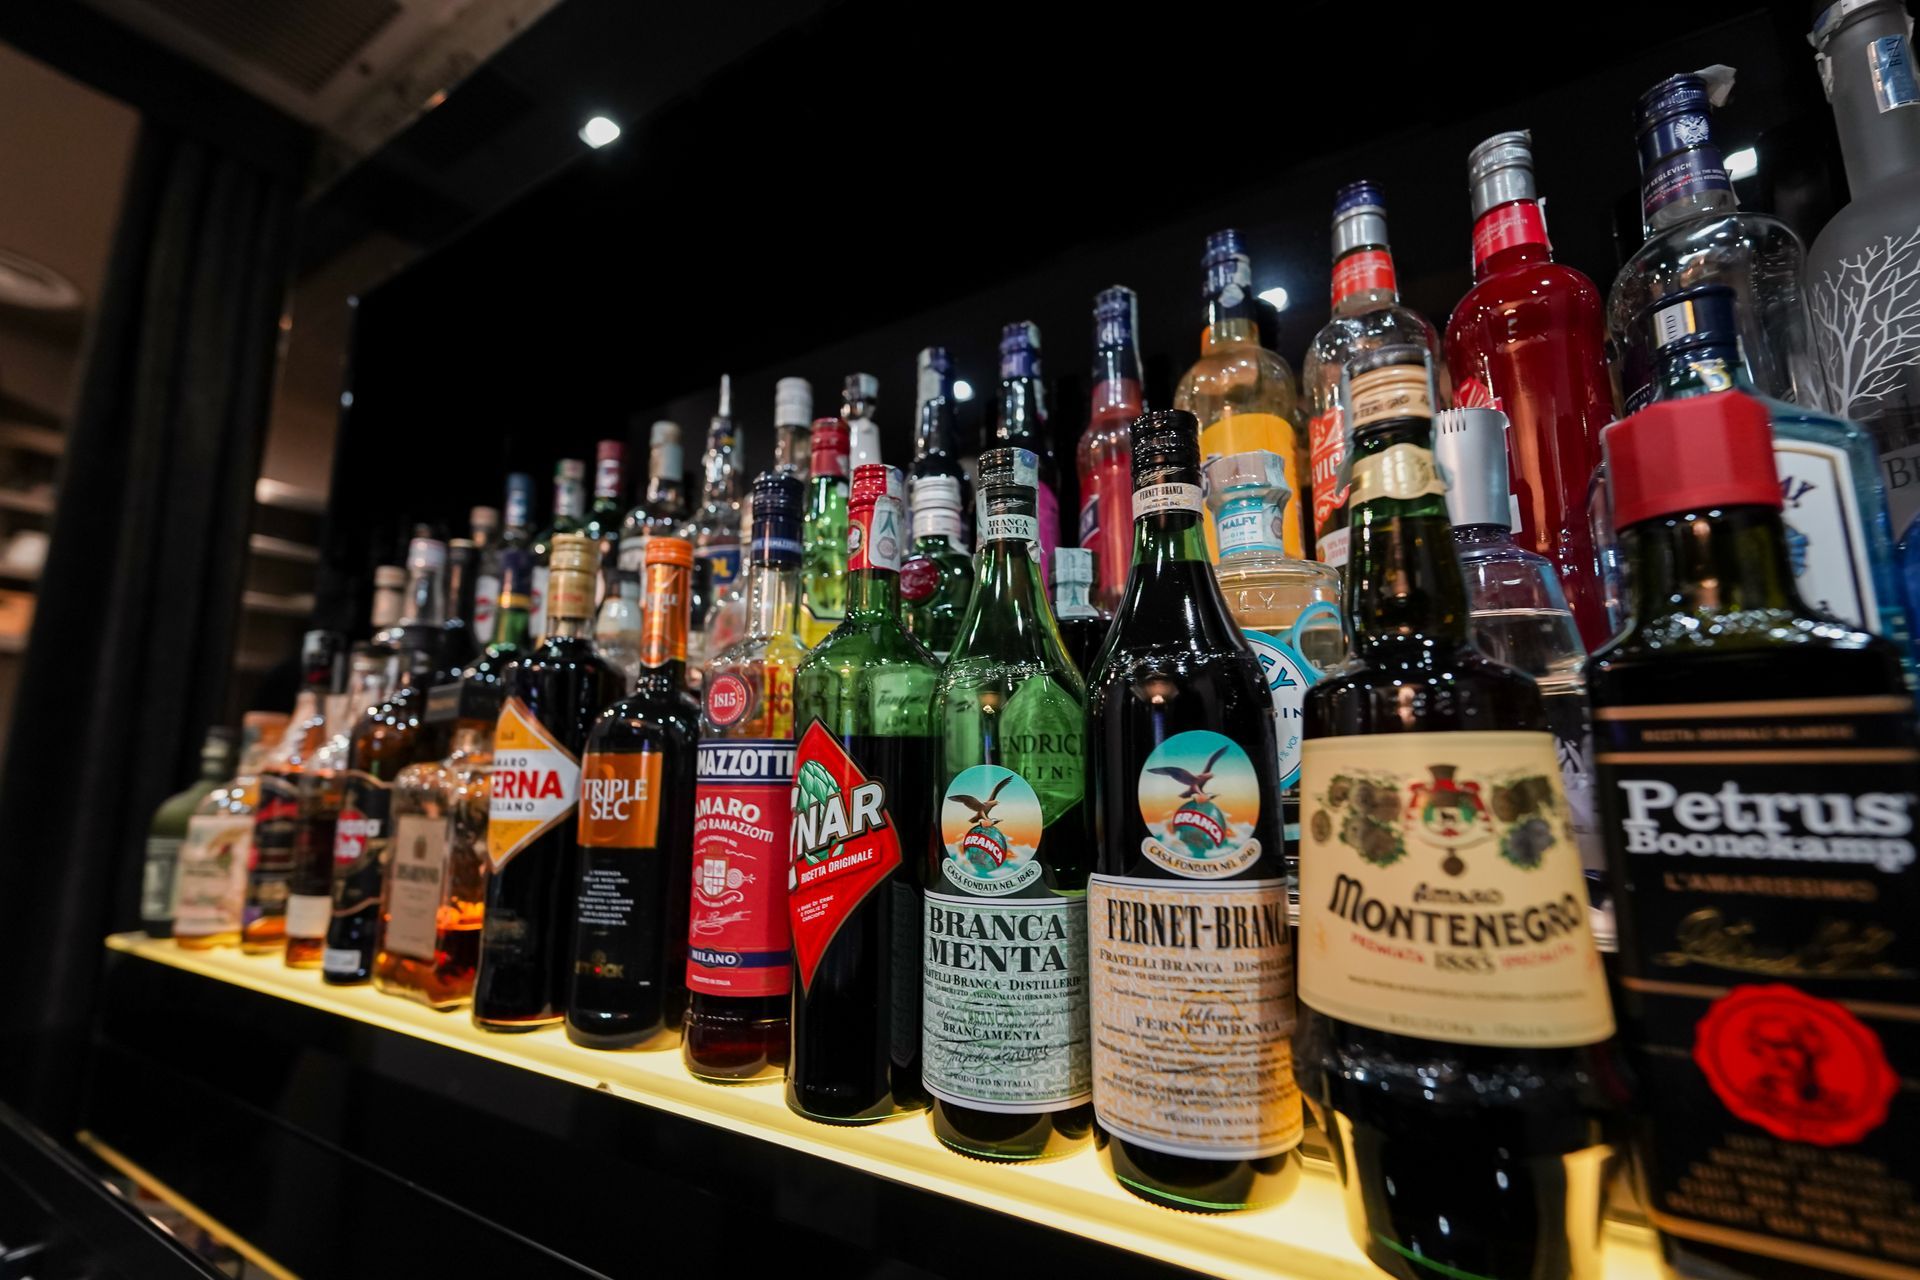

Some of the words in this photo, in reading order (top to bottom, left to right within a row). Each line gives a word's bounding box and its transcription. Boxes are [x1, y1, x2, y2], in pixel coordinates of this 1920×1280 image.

[714, 692, 736, 708] 1815
[584, 778, 648, 801] TRIPLE
[590, 799, 630, 821] SEC
[1617, 779, 1914, 837] Petrus
[709, 818, 774, 843] RAMAZZOTTI
[1174, 812, 1221, 844] BRANCA
[965, 835, 1003, 863] BRANCA
[1150, 845, 1172, 865] CASA
[1174, 859, 1219, 873] FONDATA
[1220, 860, 1236, 871] NEL
[1623, 825, 1917, 873] Boonekamp
[801, 866, 827, 883] RICETTA
[828, 849, 873, 872] ORIGINALE
[947, 865, 963, 883] CASA
[963, 877, 998, 891] FONDATA
[1000, 881, 1015, 891] NEL
[1017, 868, 1035, 884] 1845
[930, 906, 1067, 942] BRANCA
[1328, 874, 1583, 949] MONTENEGRO
[692, 949, 736, 964] MILANO
[929, 936, 1068, 973] MENTA
[1100, 949, 1157, 969] FRATELLI
[1162, 960, 1222, 973] BRANCA
[953, 974, 1000, 990] BRANCA
[943, 1022, 1040, 1042] BRANCAMENTA
[1003, 1080, 1033, 1088] ITALIA
